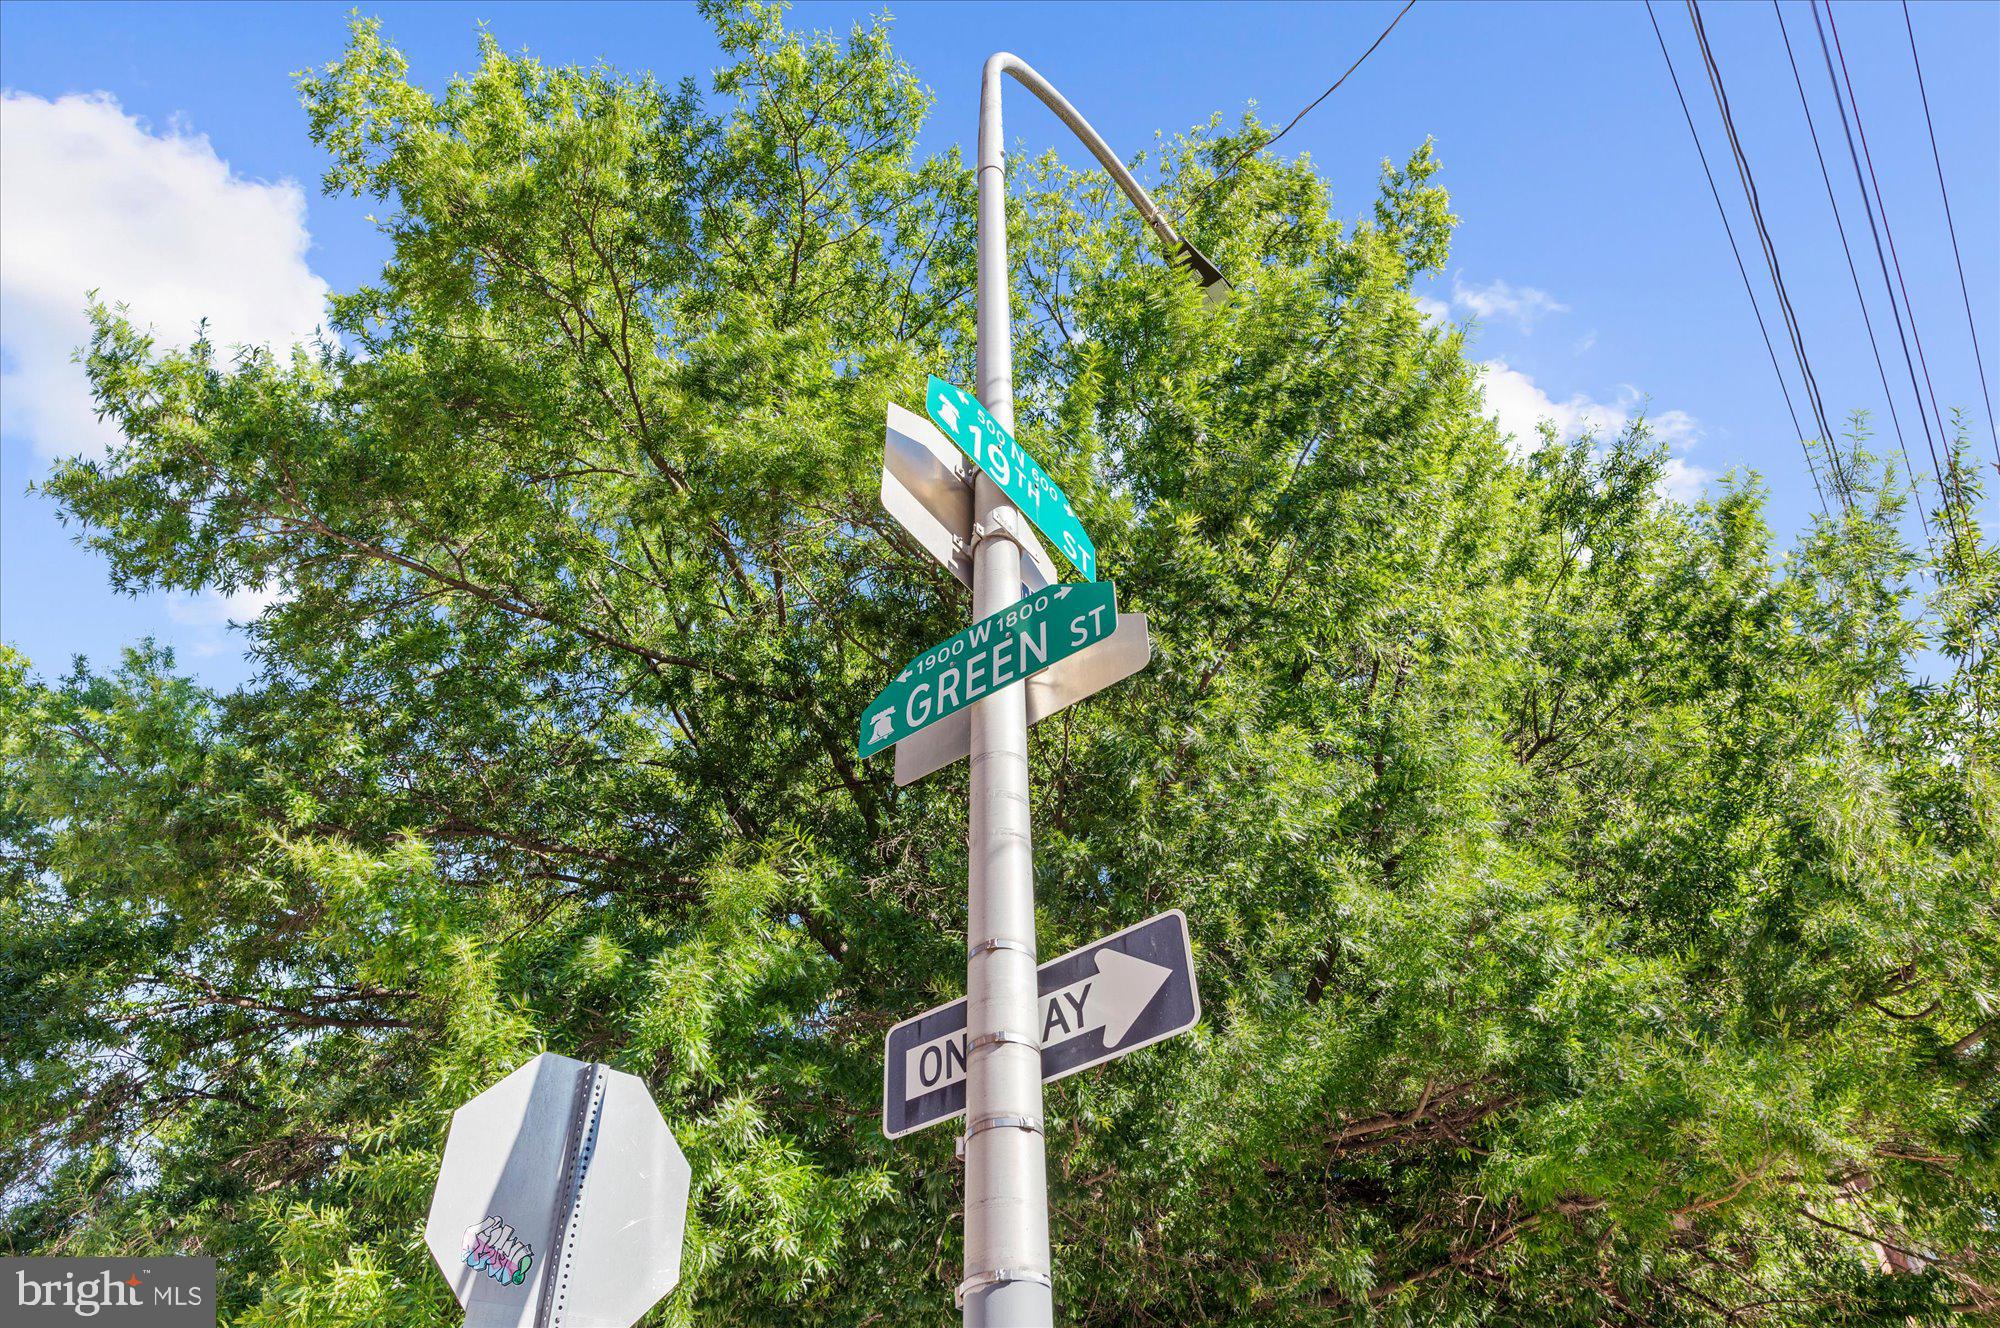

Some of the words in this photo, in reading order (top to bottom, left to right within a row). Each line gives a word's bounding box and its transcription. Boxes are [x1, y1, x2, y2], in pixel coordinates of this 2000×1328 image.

[977, 410, 1006, 445] 500
[1011, 442, 1025, 468] N
[1031, 469, 1058, 501] 600
[1063, 530, 1091, 572] ST
[906, 621, 1048, 728] GREEN
[1070, 605, 1106, 647] ST
[916, 639, 964, 675] 1900
[968, 620, 992, 648] W
[996, 596, 1049, 632] 1800
[919, 1033, 967, 1087] ON
[1042, 982, 1092, 1043] AY
